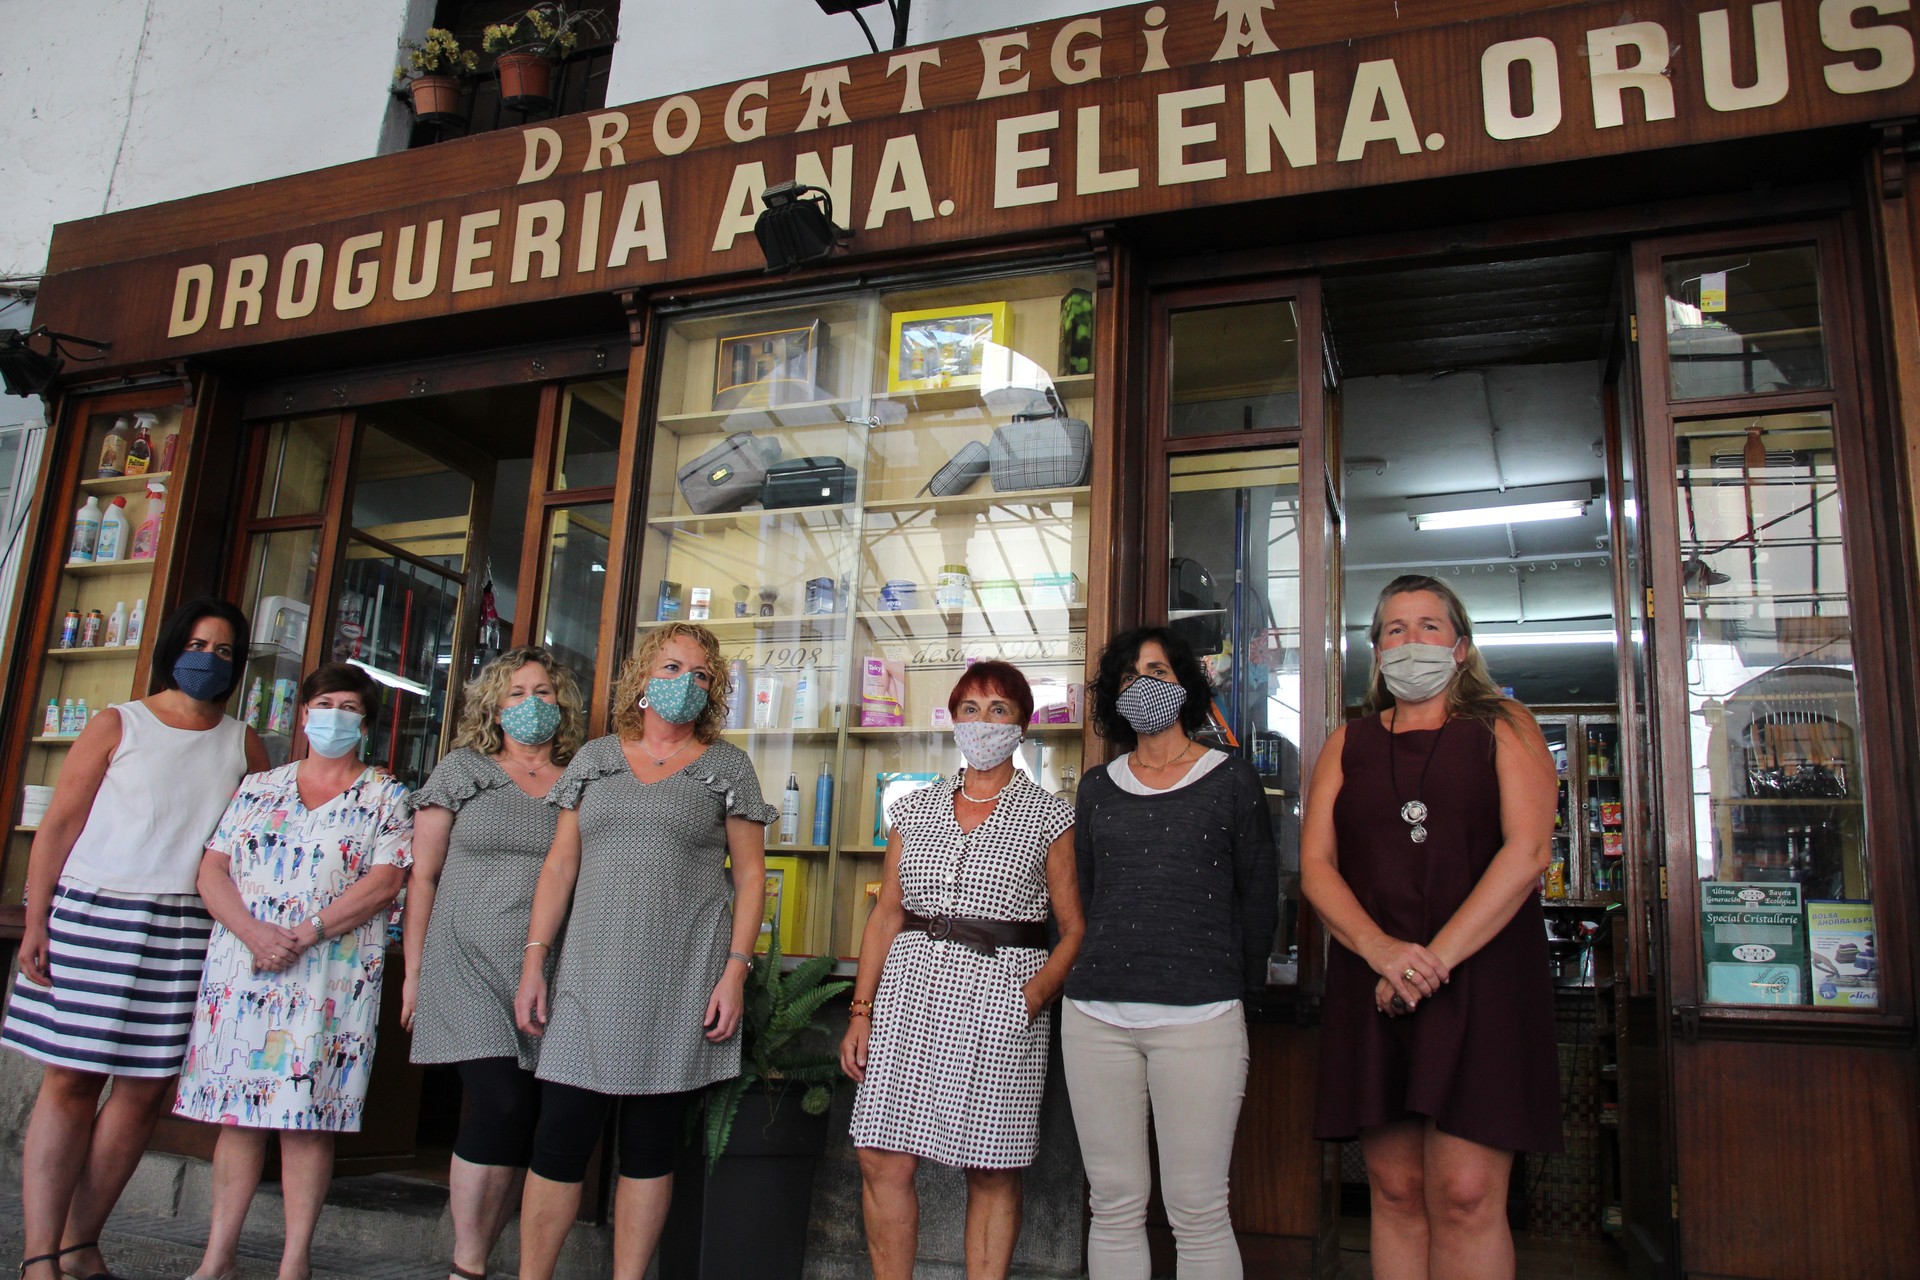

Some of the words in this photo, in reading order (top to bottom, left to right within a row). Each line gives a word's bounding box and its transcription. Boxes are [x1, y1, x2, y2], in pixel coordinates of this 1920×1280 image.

[167, 180, 668, 338] DROGUERIA
[711, 134, 955, 252] ANA.
[994, 58, 1445, 210] ELENA.
[1480, 0, 1915, 141] ORUS
[760, 647, 822, 667] 1908
[1712, 887, 1735, 895] Última
[1768, 889, 1791, 898] Bayeta
[1707, 912, 1741, 926] Special
[1743, 912, 1798, 924] Cristallerie
